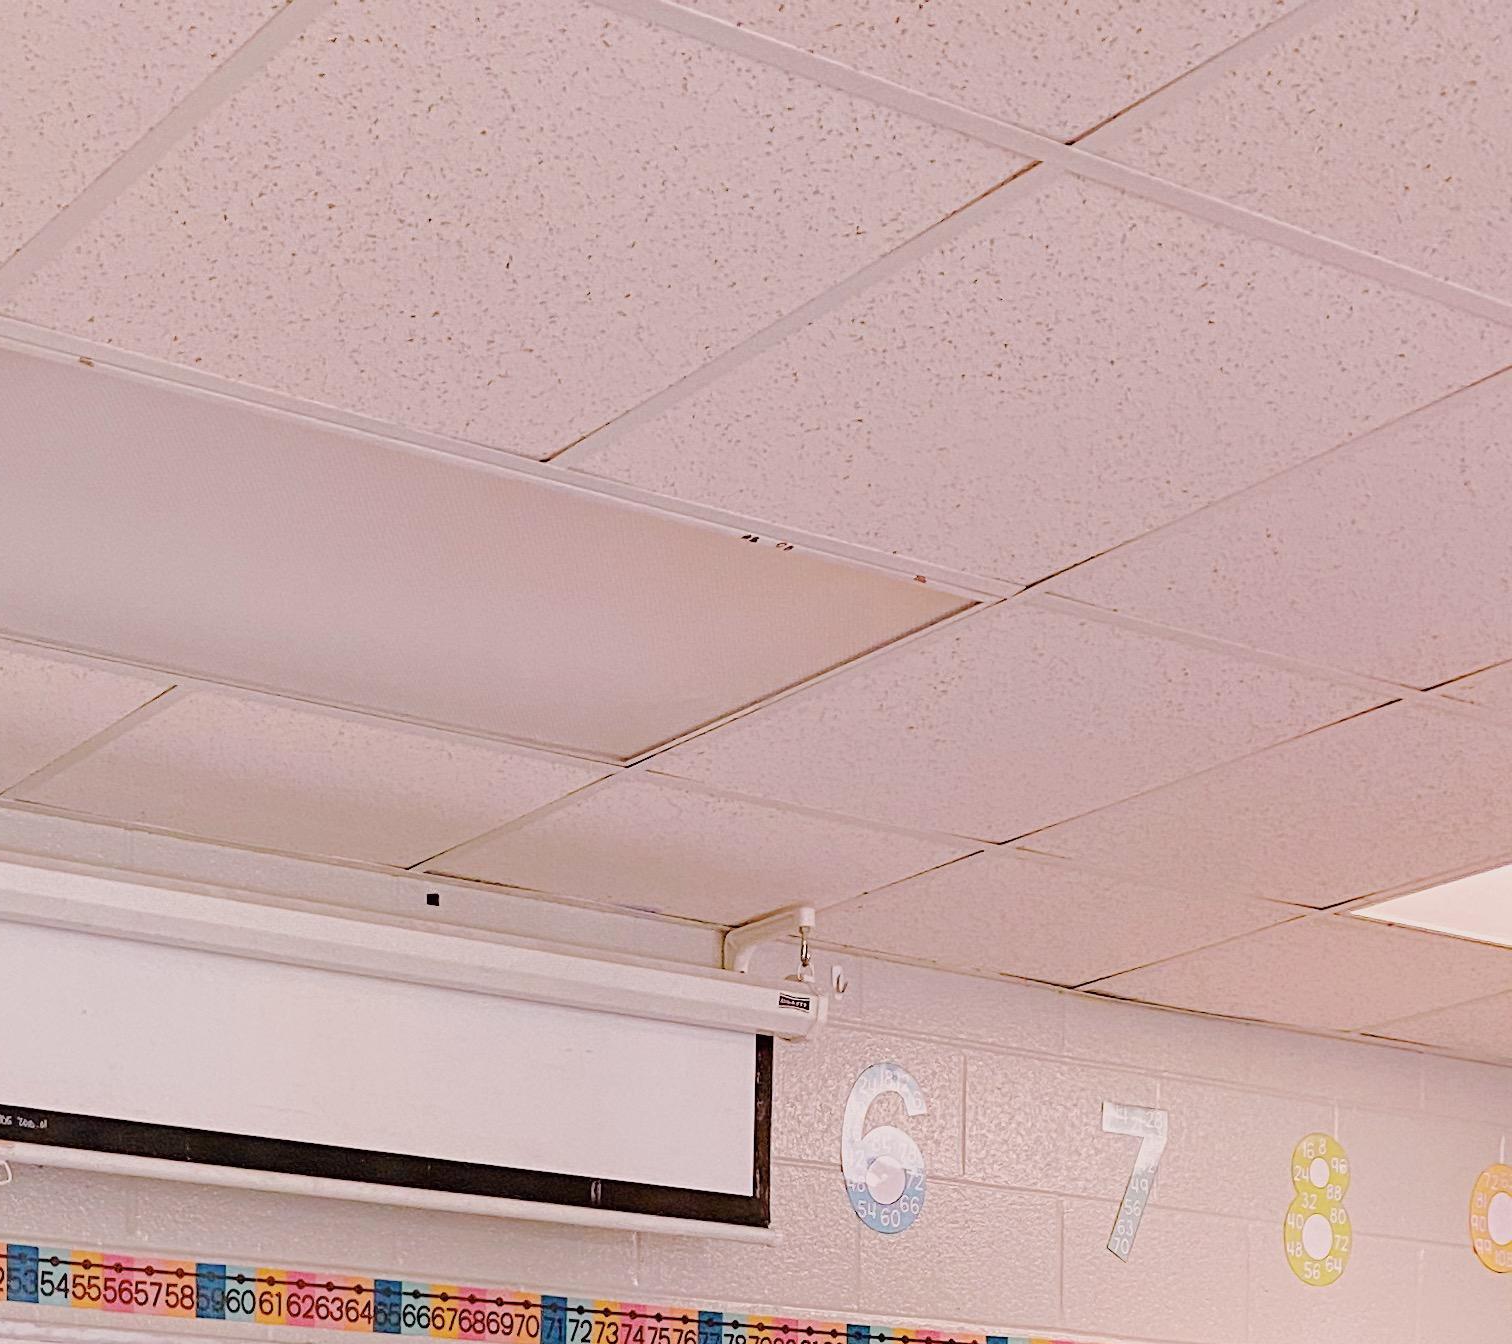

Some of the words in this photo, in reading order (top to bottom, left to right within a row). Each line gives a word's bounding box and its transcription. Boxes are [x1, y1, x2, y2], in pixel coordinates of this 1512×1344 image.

[40, 1271, 69, 1298] 54
[103, 1278, 133, 1304] 56
[165, 1284, 194, 1310] 58
[226, 1288, 255, 1314] 60
[569, 1319, 592, 1343] 72
